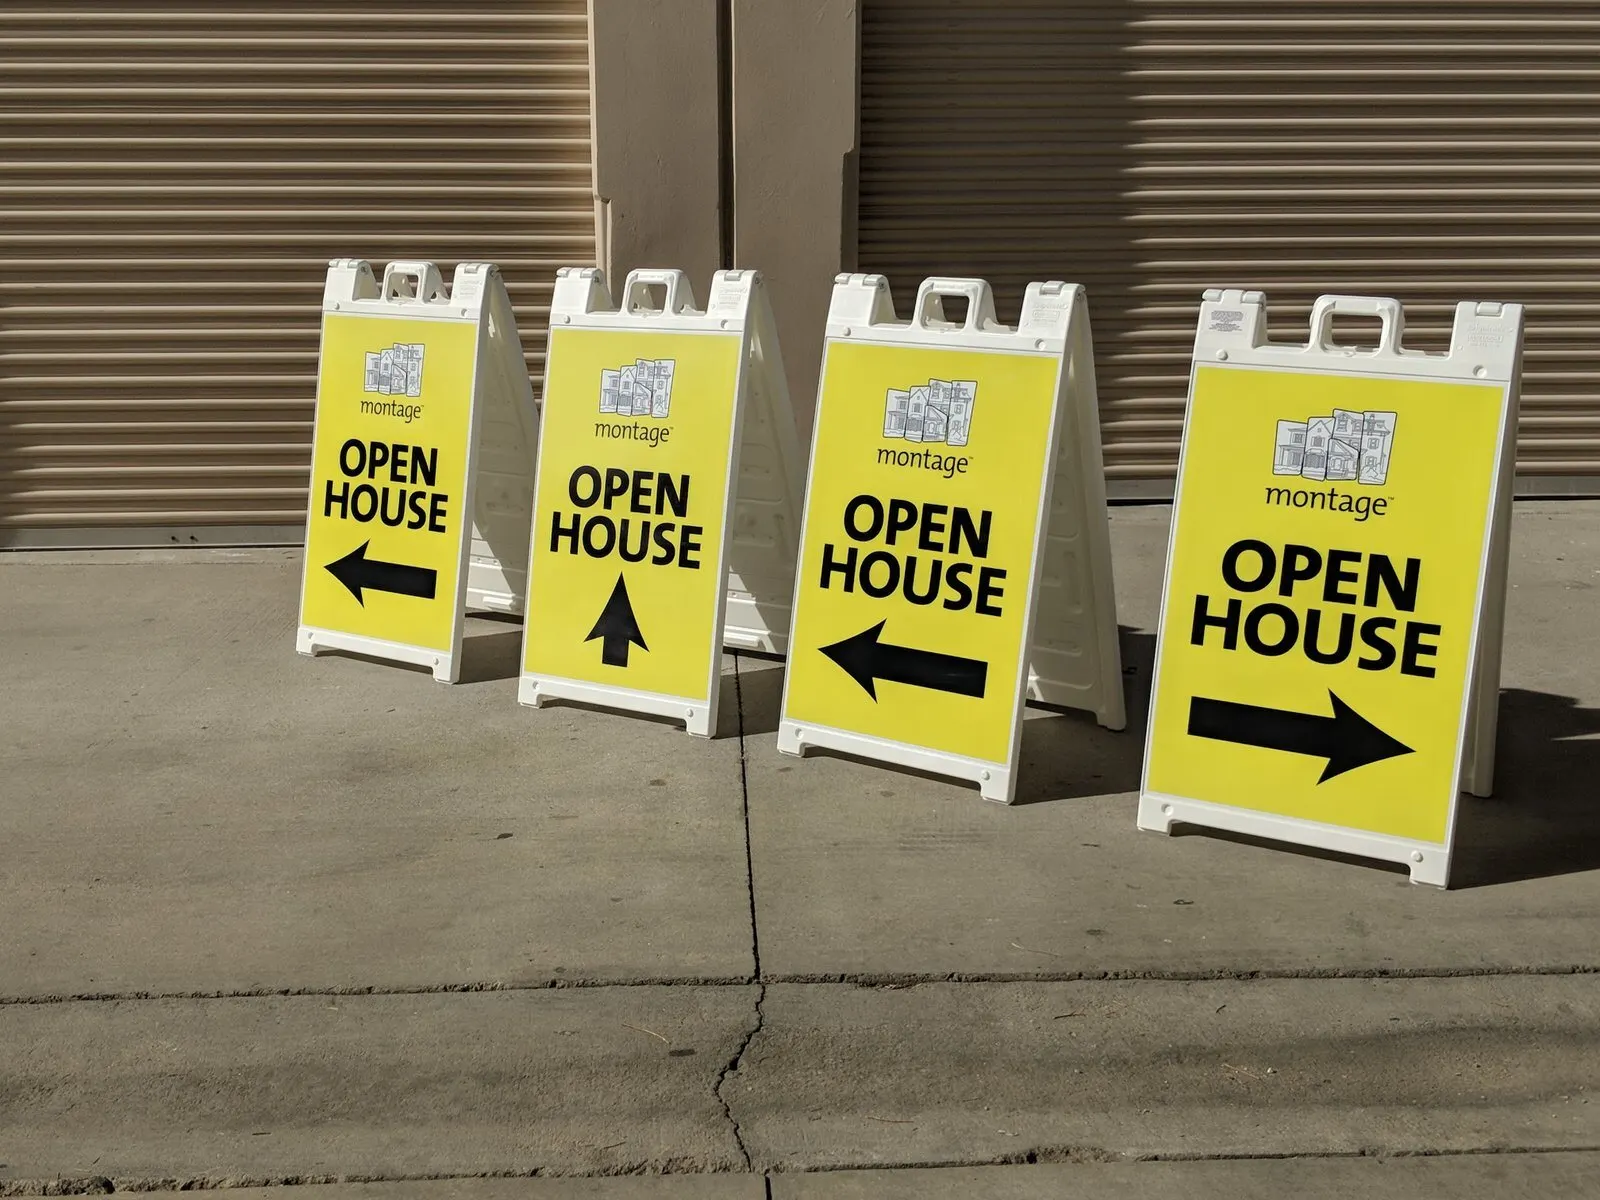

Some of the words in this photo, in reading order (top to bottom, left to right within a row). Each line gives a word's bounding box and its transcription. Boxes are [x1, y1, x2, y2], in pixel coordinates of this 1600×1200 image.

[339, 438, 438, 487] OPEN
[568, 465, 691, 518] OPEN
[323, 479, 449, 534] HOUSE
[843, 494, 993, 559] OPEN
[549, 511, 704, 570] HOUSE
[819, 543, 1008, 618] HOUSE
[1221, 539, 1422, 613] OPEN
[1190, 594, 1442, 679] HOUSE
